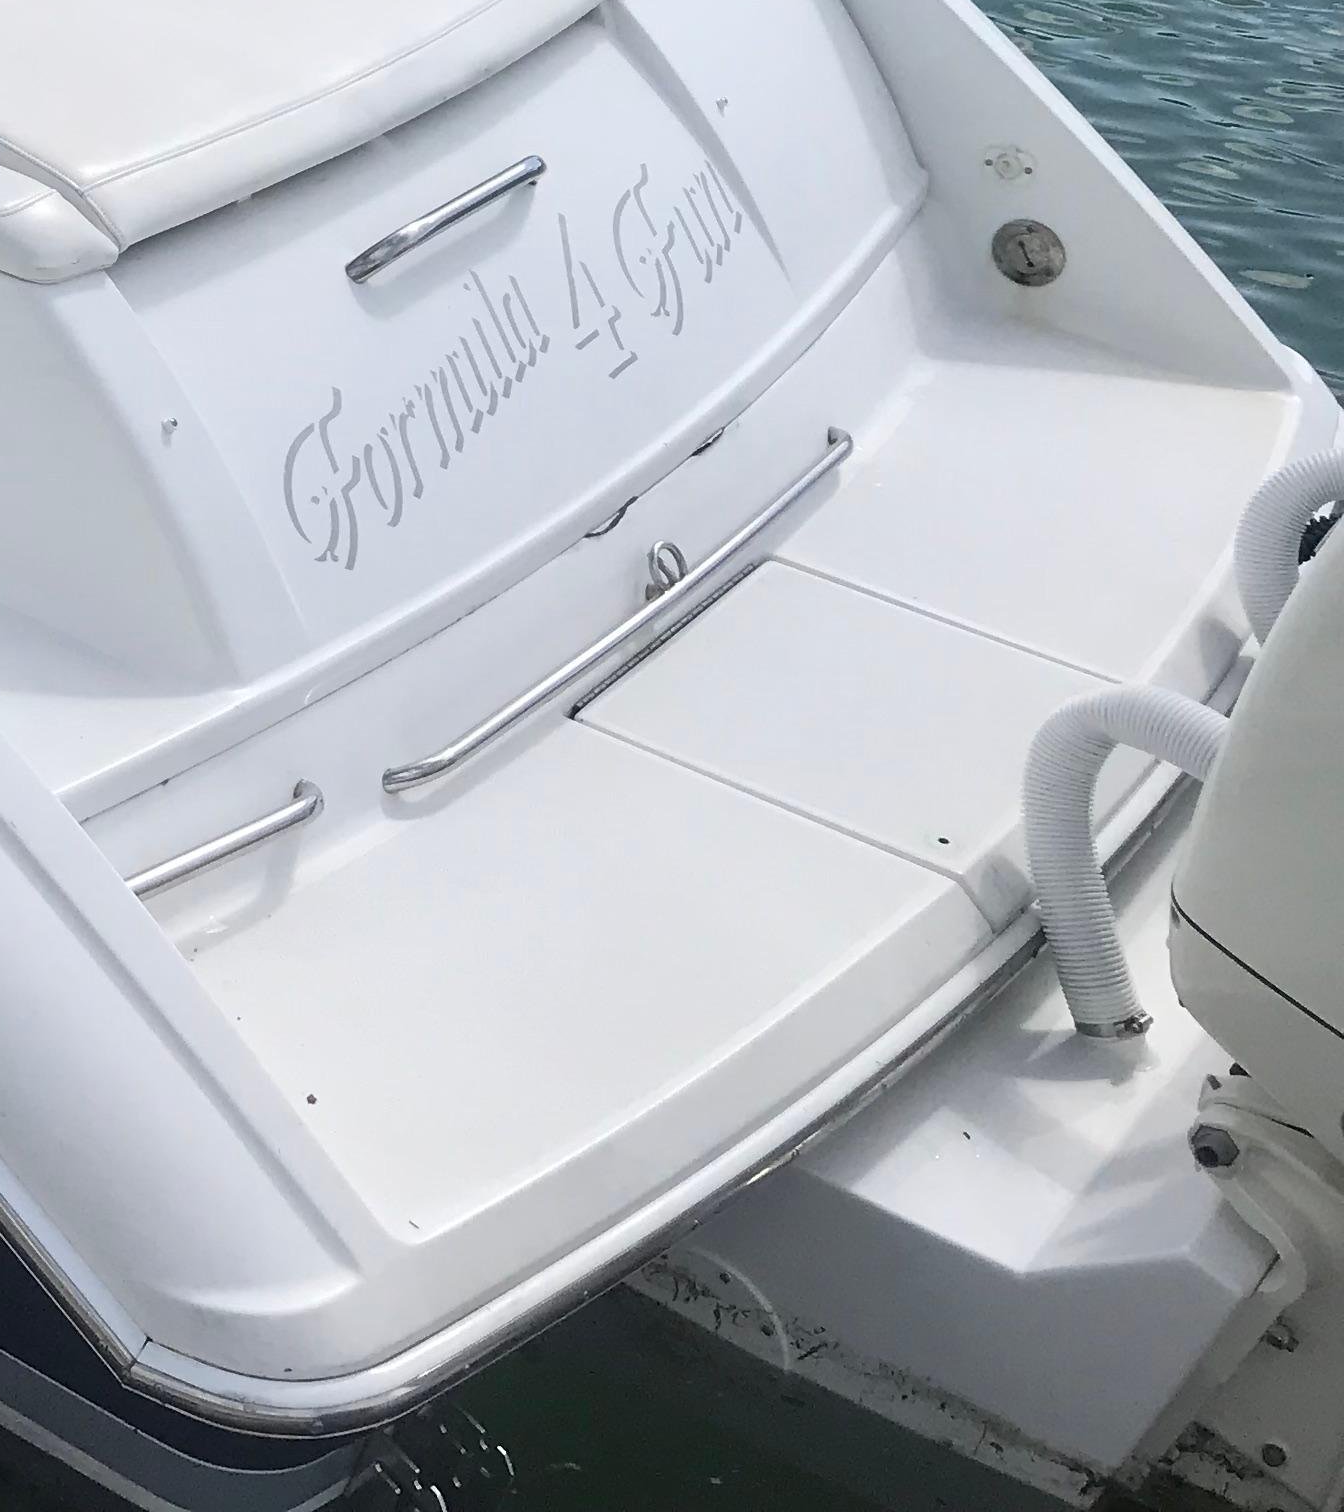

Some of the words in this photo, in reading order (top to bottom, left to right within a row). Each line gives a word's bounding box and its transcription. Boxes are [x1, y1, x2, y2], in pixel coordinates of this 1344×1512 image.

[283, 268, 550, 571] Formula
[558, 212, 638, 379] 4
[612, 160, 744, 336] Fun
